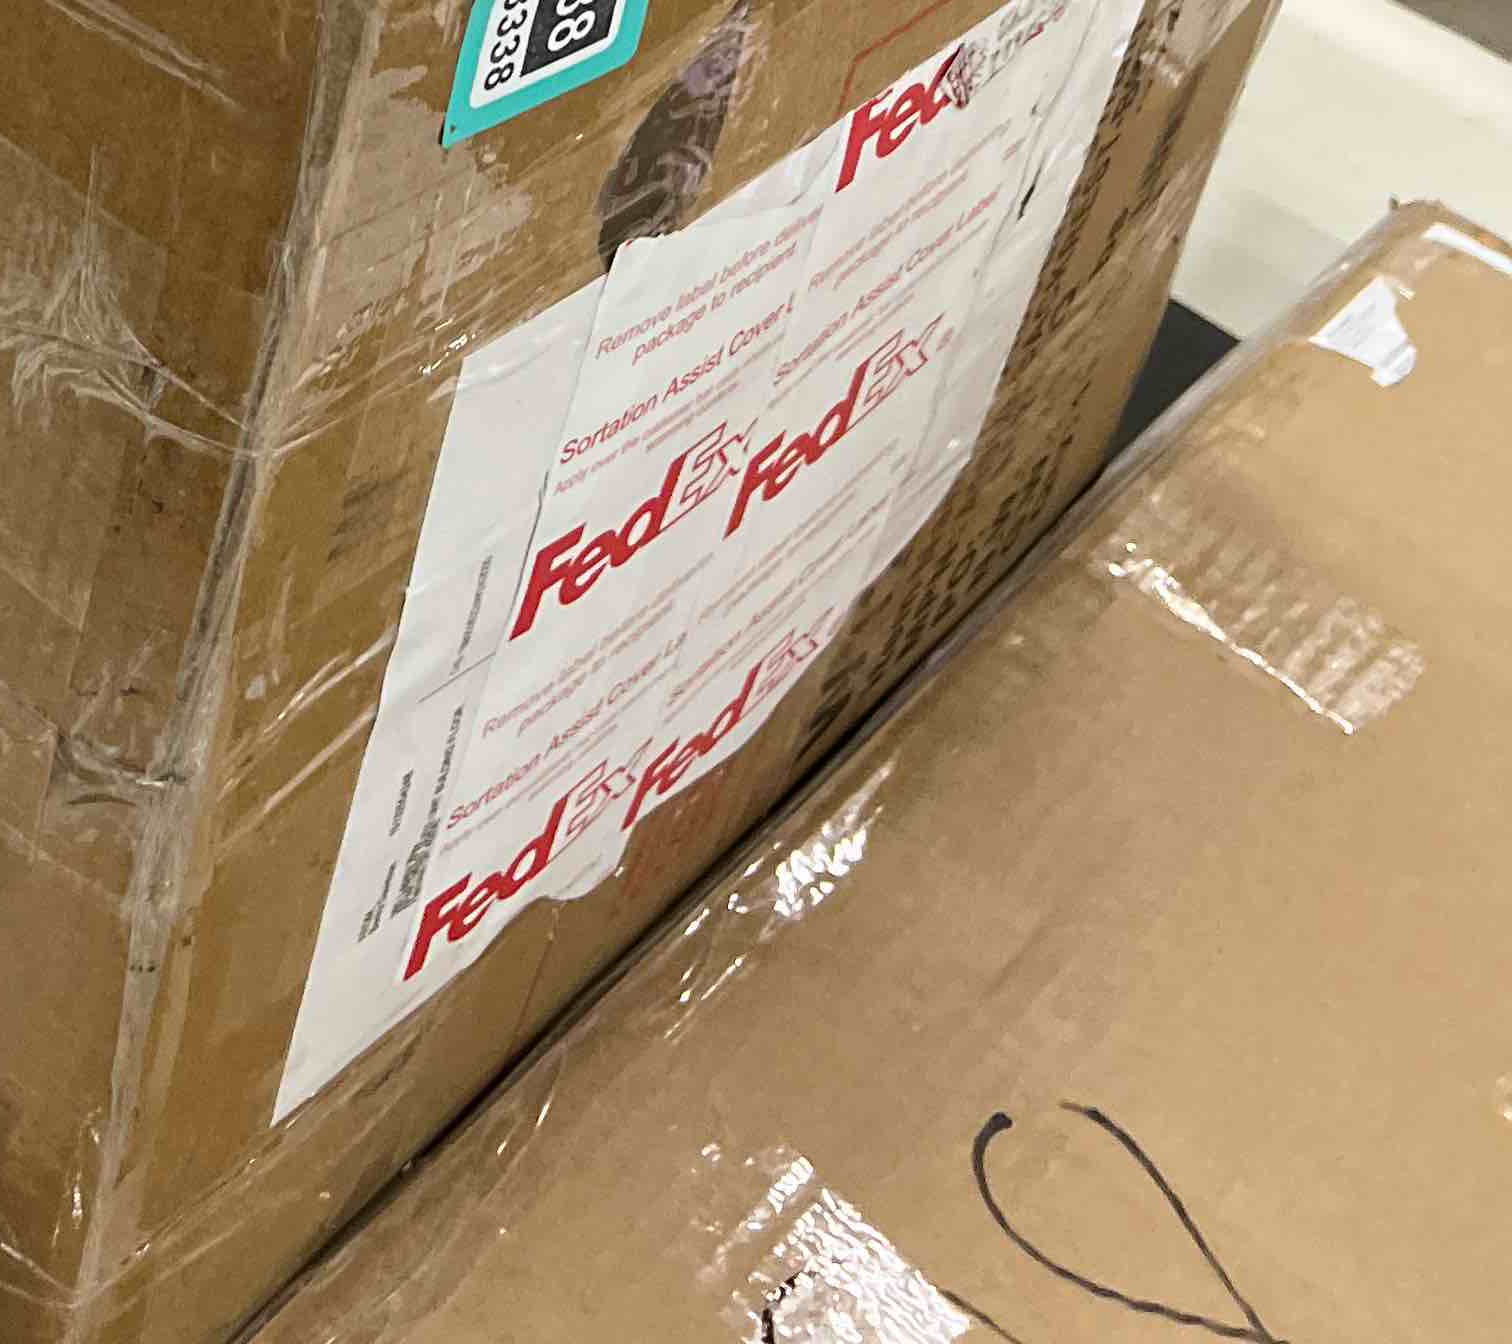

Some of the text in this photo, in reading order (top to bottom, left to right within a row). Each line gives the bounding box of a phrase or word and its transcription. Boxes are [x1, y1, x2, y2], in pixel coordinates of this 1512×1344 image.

[559, 303, 785, 465] Sortation Assist Cover
[594, 305, 673, 359] Remove
[675, 272, 716, 312] label
[630, 304, 707, 366] package
[709, 292, 728, 311] to
[730, 241, 798, 299] recipient
[724, 310, 944, 539] FedEx
[509, 417, 757, 642] FedEx
[447, 752, 543, 830] Sortation
[546, 699, 605, 757] Assist
[621, 602, 837, 832] FedEx
[402, 734, 655, 983] FedEx
